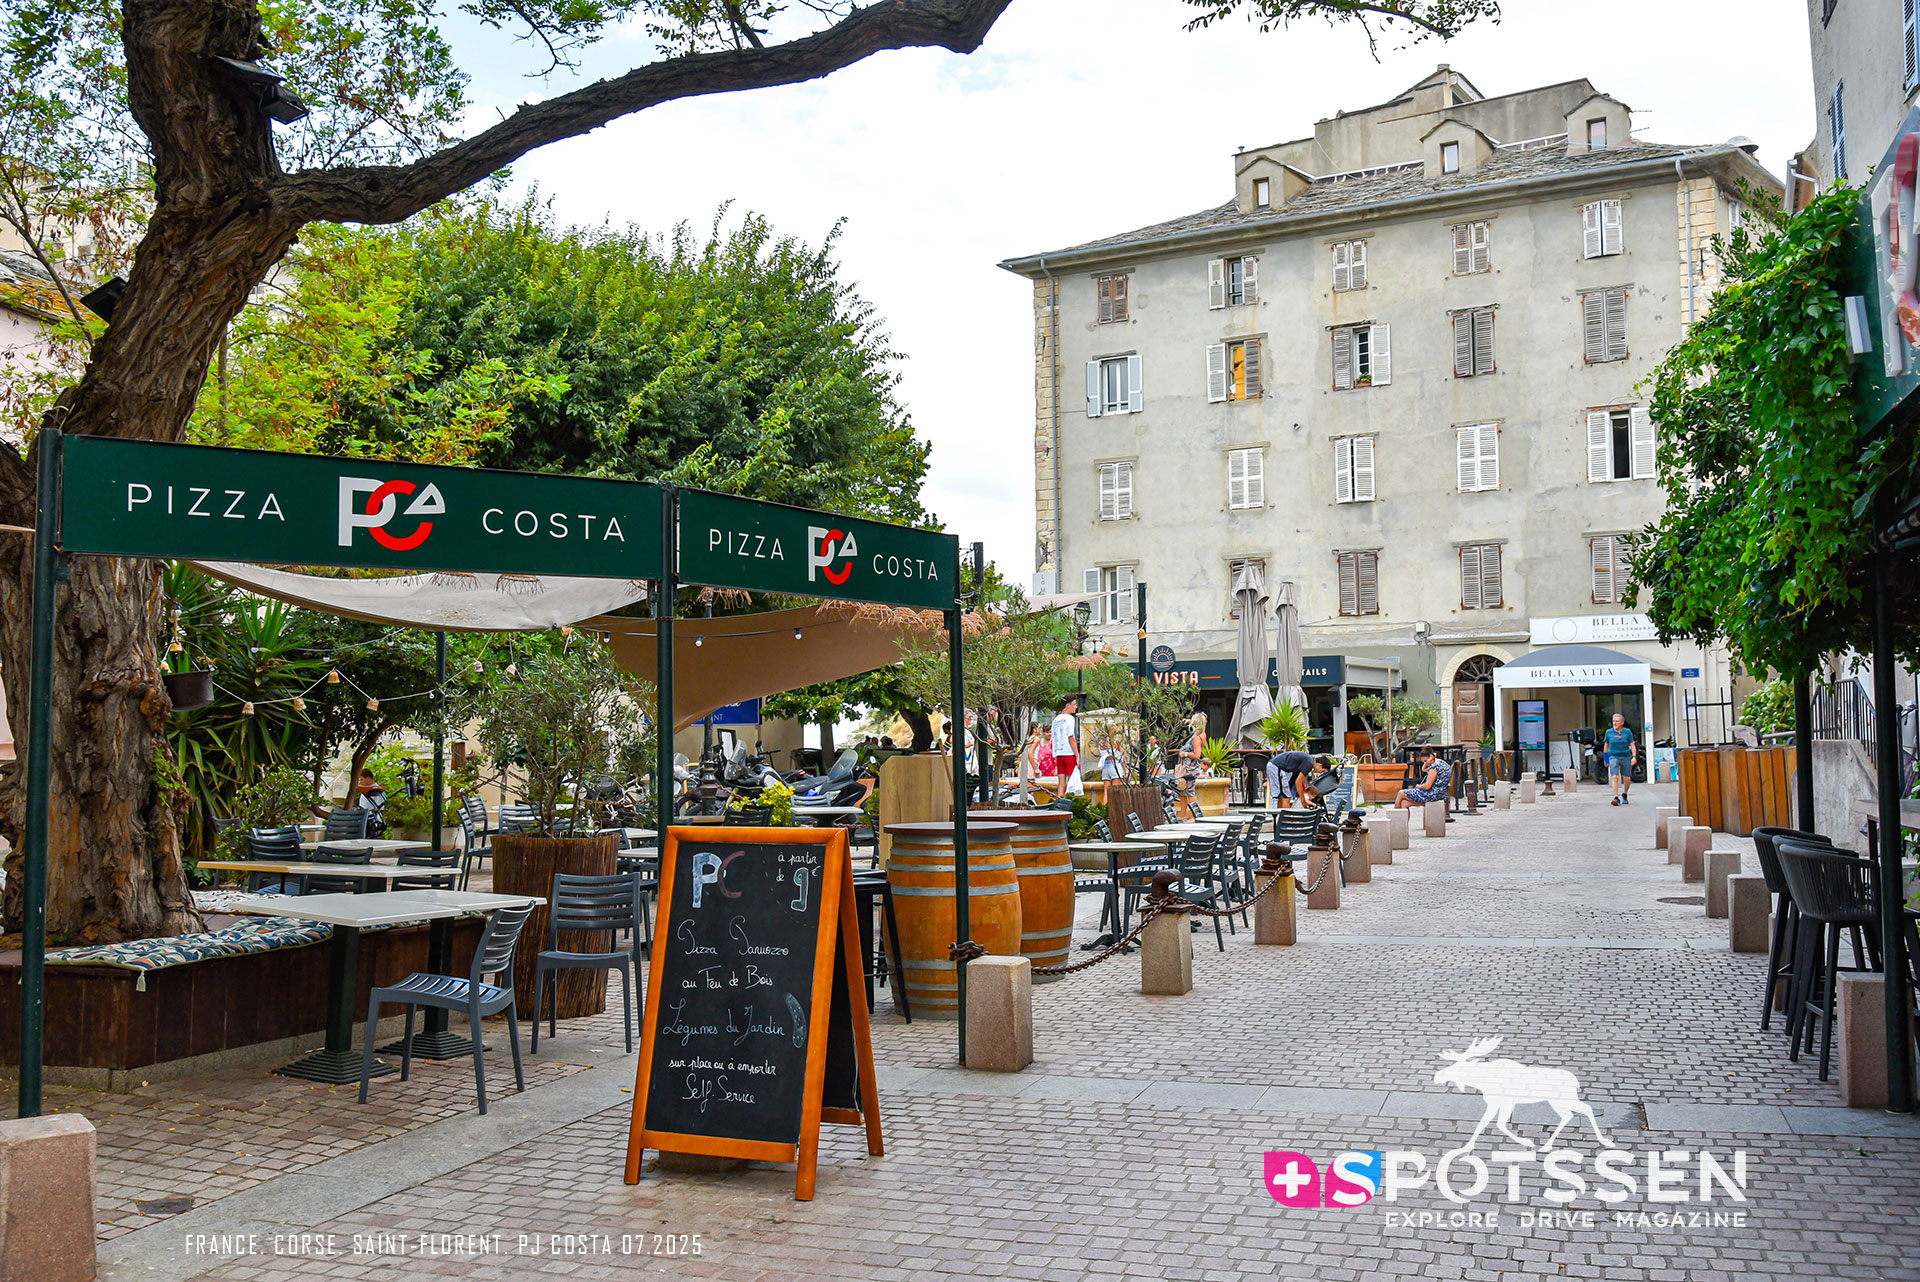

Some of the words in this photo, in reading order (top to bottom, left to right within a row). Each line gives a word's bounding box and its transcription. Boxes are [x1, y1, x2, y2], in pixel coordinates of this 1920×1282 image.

[127, 483, 286, 522] PIZZA
[482, 508, 625, 542] COSTA
[709, 528, 785, 561] PIZZA
[872, 554, 939, 581] COSTA
[1592, 617, 1640, 627] BELLA
[1153, 671, 1198, 686] VISTA
[1530, 669, 1576, 678] BELLA
[1582, 667, 1615, 677] VITA
[788, 851, 818, 865] partir
[776, 868, 785, 882] de
[676, 918, 718, 955] Pizza
[682, 979, 698, 989] au
[698, 964, 722, 989] Feu
[729, 970, 739, 987] de
[745, 964, 774, 989] Bois
[662, 997, 719, 1047] Légumes
[726, 1008, 740, 1033] du
[733, 1004, 786, 1047] Jardin
[669, 1059, 686, 1068] sur
[688, 1055, 713, 1071] place
[714, 1062, 725, 1071] ou
[727, 1057, 736, 1071] à
